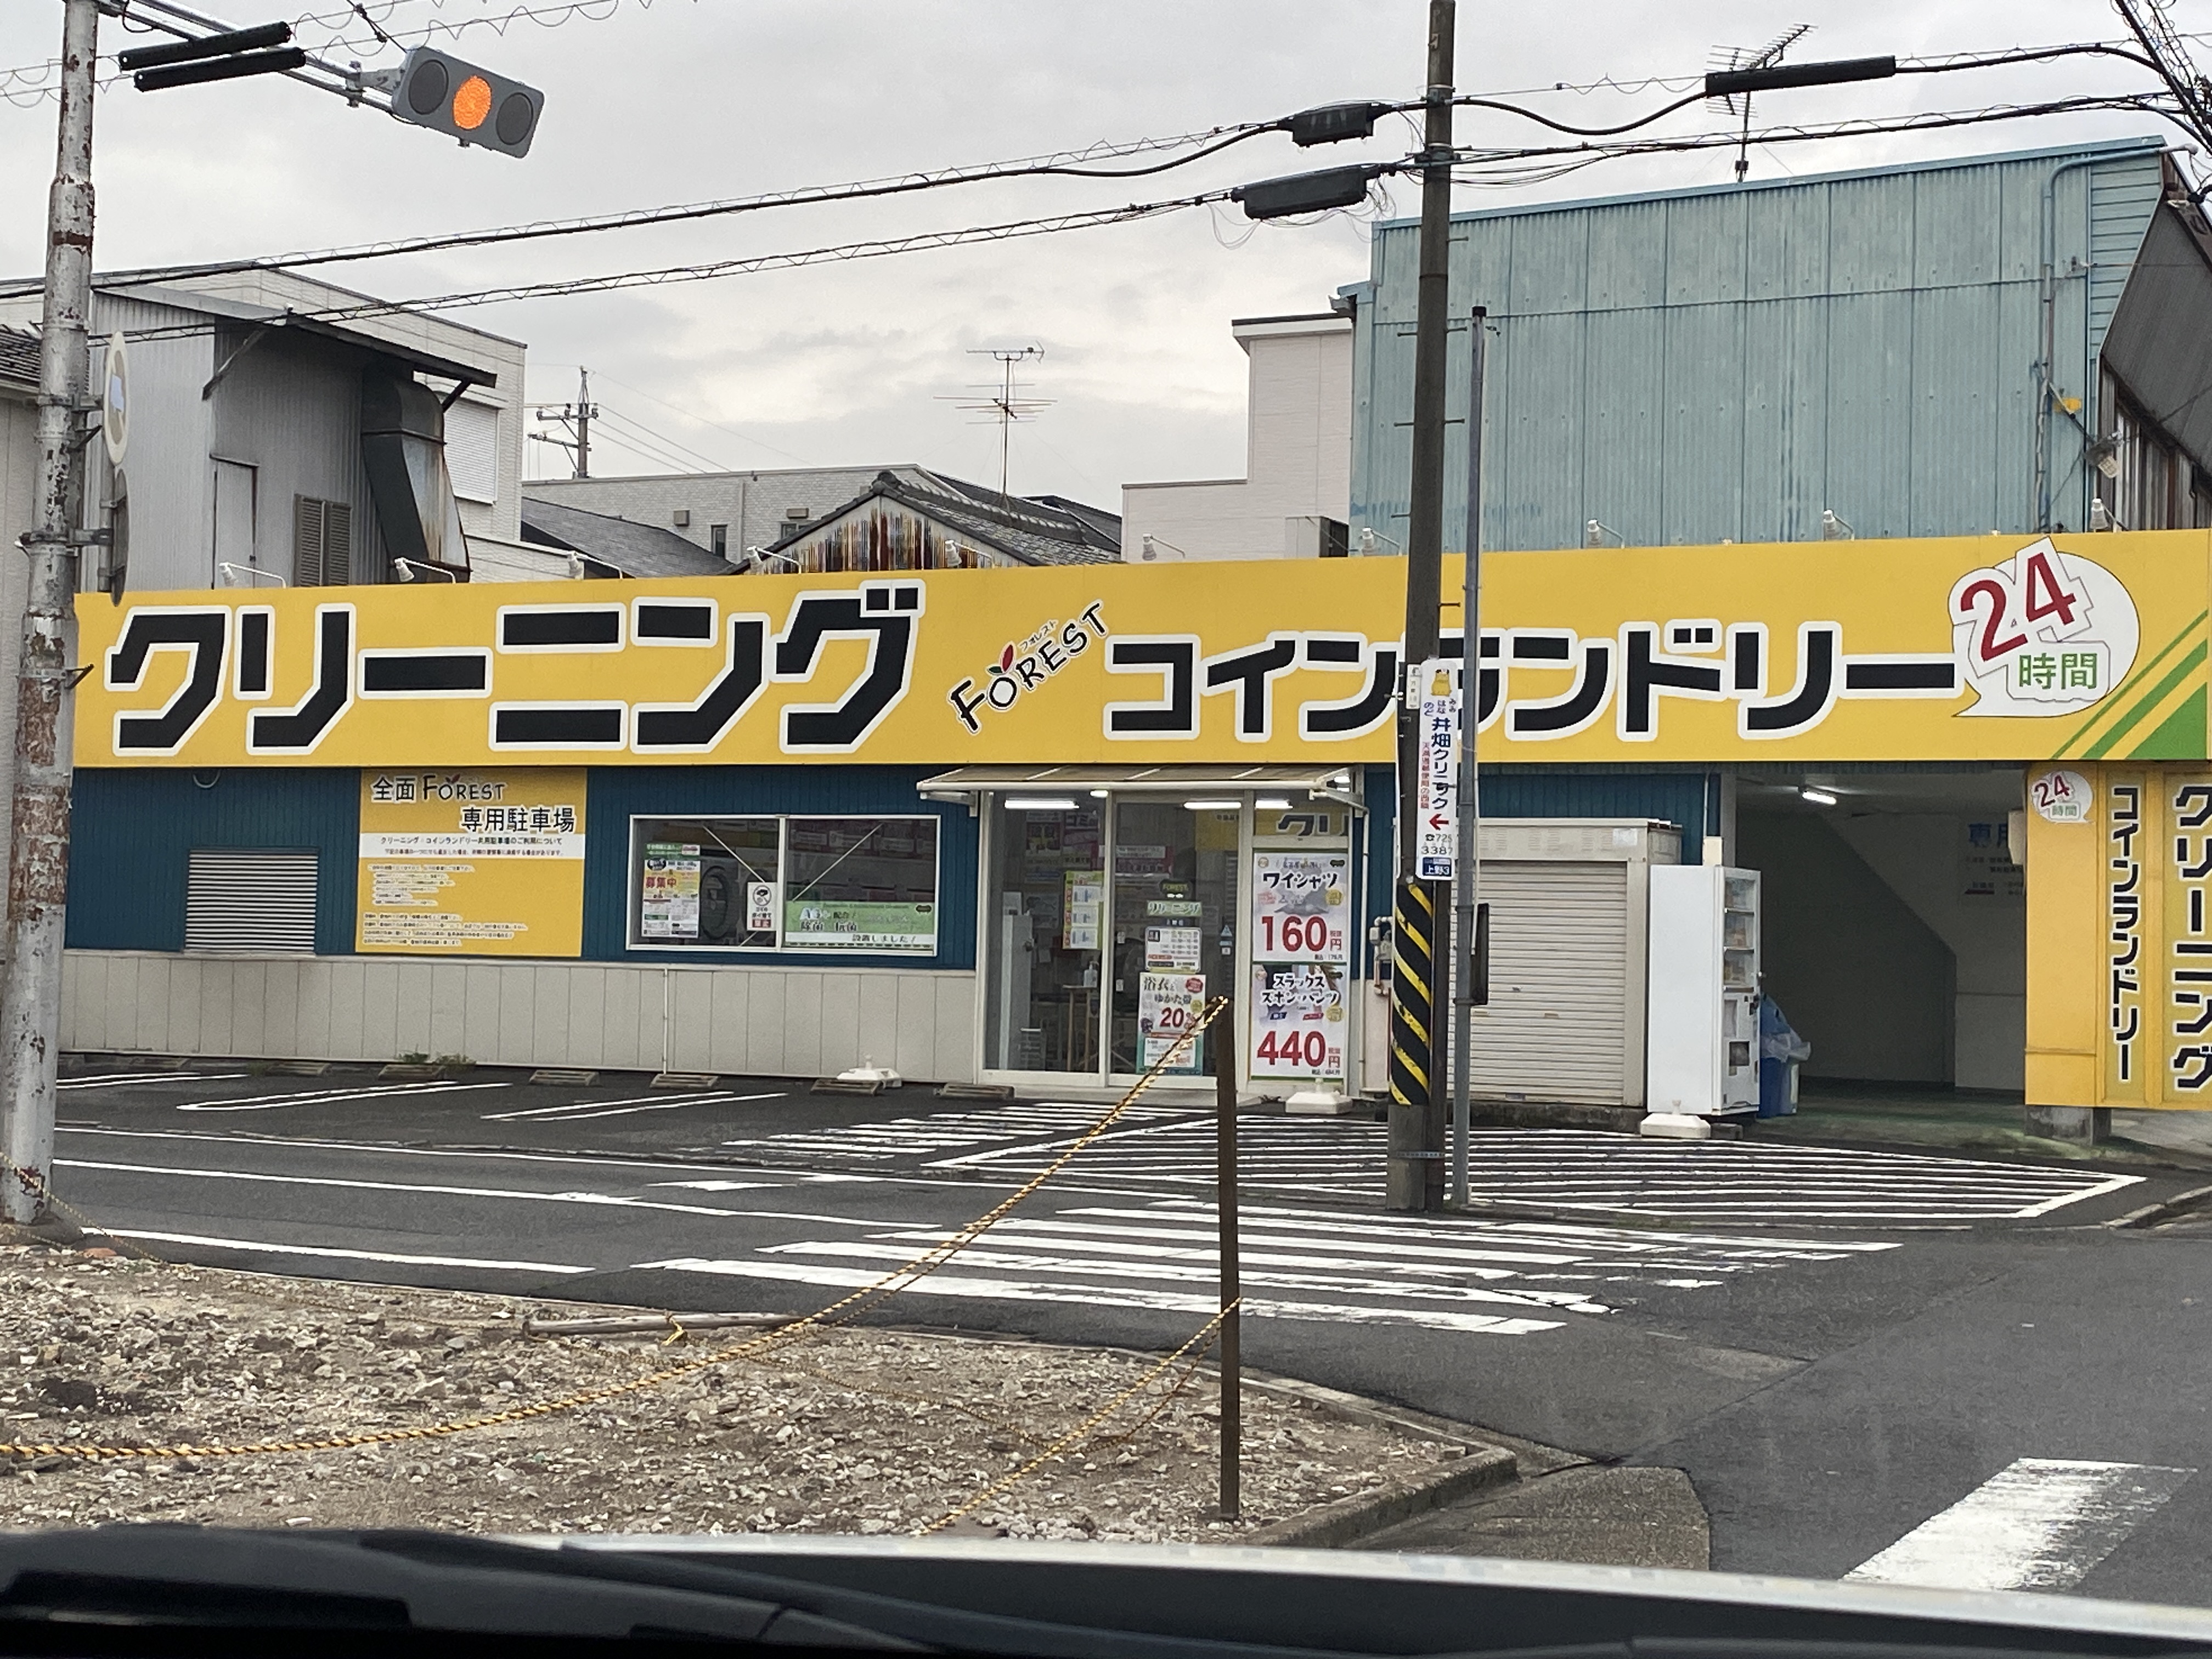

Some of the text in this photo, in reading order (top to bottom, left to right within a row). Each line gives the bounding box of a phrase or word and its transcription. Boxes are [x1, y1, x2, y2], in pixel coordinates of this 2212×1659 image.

[1960, 552, 2076, 662] 24
[110, 587, 920, 750] クリーニング
[951, 603, 1105, 731] FOREST
[2018, 653, 2098, 690] 時間
[1431, 716, 1451, 810] 井畑クリニック
[373, 775, 506, 800] 全面 FOREST
[2034, 775, 2069, 807] 24
[461, 806, 575, 832] 専用駐車場
[1420, 846, 1453, 855] 3387
[1263, 873, 1338, 889] ワイシャツ
[1262, 916, 1327, 952] 160
[2113, 788, 2138, 1080] コインランドリー
[2174, 786, 2212, 1088] クリーニング
[1274, 975, 1325, 988] スラックス
[1256, 1030, 1326, 1067] 440
